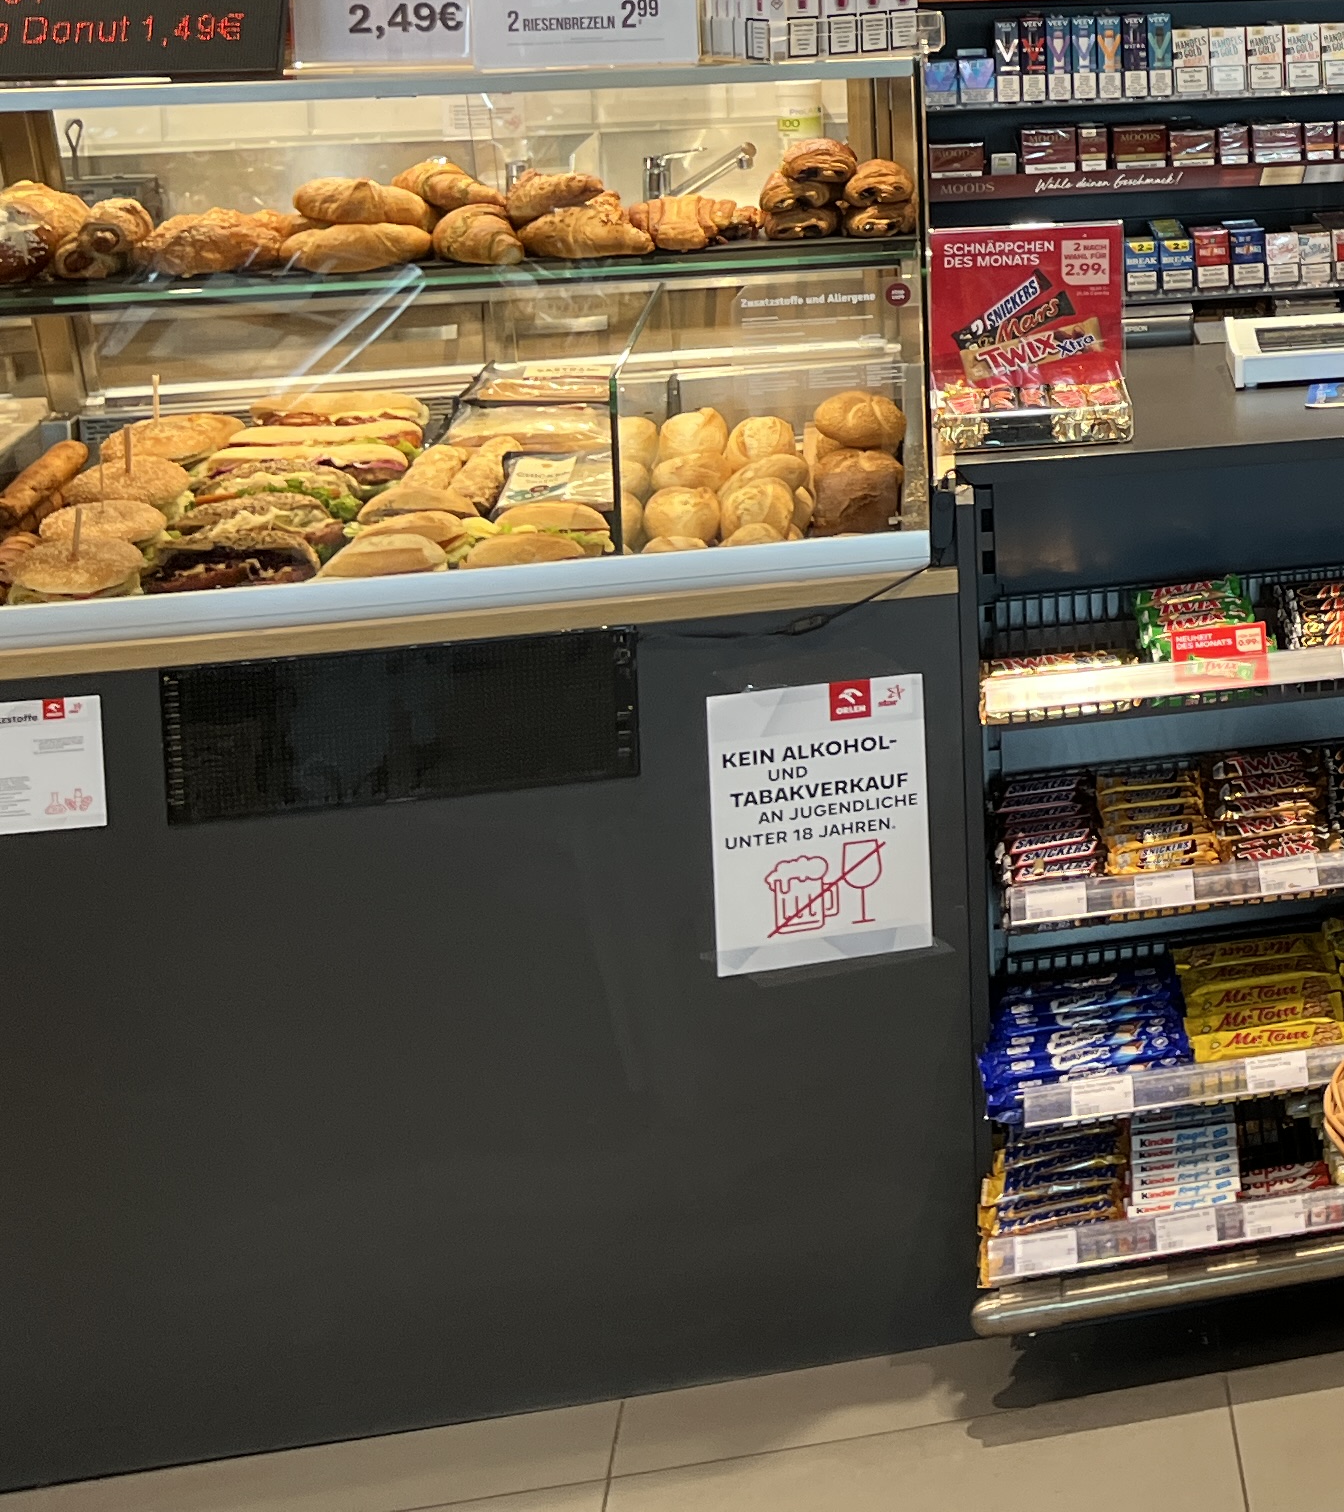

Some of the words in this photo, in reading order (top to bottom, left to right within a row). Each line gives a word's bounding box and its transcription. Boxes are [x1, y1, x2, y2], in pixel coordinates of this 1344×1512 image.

[23, 16, 130, 45] Donut
[142, 13, 245, 47] 1,49€
[348, 1, 464, 39] 2,49€
[507, 10, 519, 32] 2
[522, 15, 615, 32] RIESENBREZELN
[940, 182, 995, 194] MOODS
[944, 240, 1055, 255] SCHNÄPPCHEN
[1074, 242, 1081, 250] 2
[1090, 251, 1107, 260] FÜR
[944, 257, 973, 268] DES
[977, 254, 1040, 267] MONATS
[986, 277, 1039, 329] SNICKERS
[996, 298, 1060, 344] Mars
[977, 334, 1057, 375] TWIX
[1057, 334, 1095, 358] Xtra
[1176, 632, 1211, 644] NEUHEIT
[1176, 641, 1193, 650] DES
[1196, 637, 1233, 649] MONATS
[836, 705, 866, 715] ORLEN
[722, 748, 775, 768] KEIN
[782, 735, 898, 762] ALKOHOL-
[767, 766, 808, 782] UND
[730, 773, 908, 808] TABAKVERKAUF
[758, 809, 783, 824] AN
[789, 793, 918, 820] JUGENDLICHE
[725, 830, 787, 850] UNTER
[793, 827, 813, 841] 18
[819, 818, 896, 838] JAHREN.
[1020, 841, 1097, 865] SNICKERS
